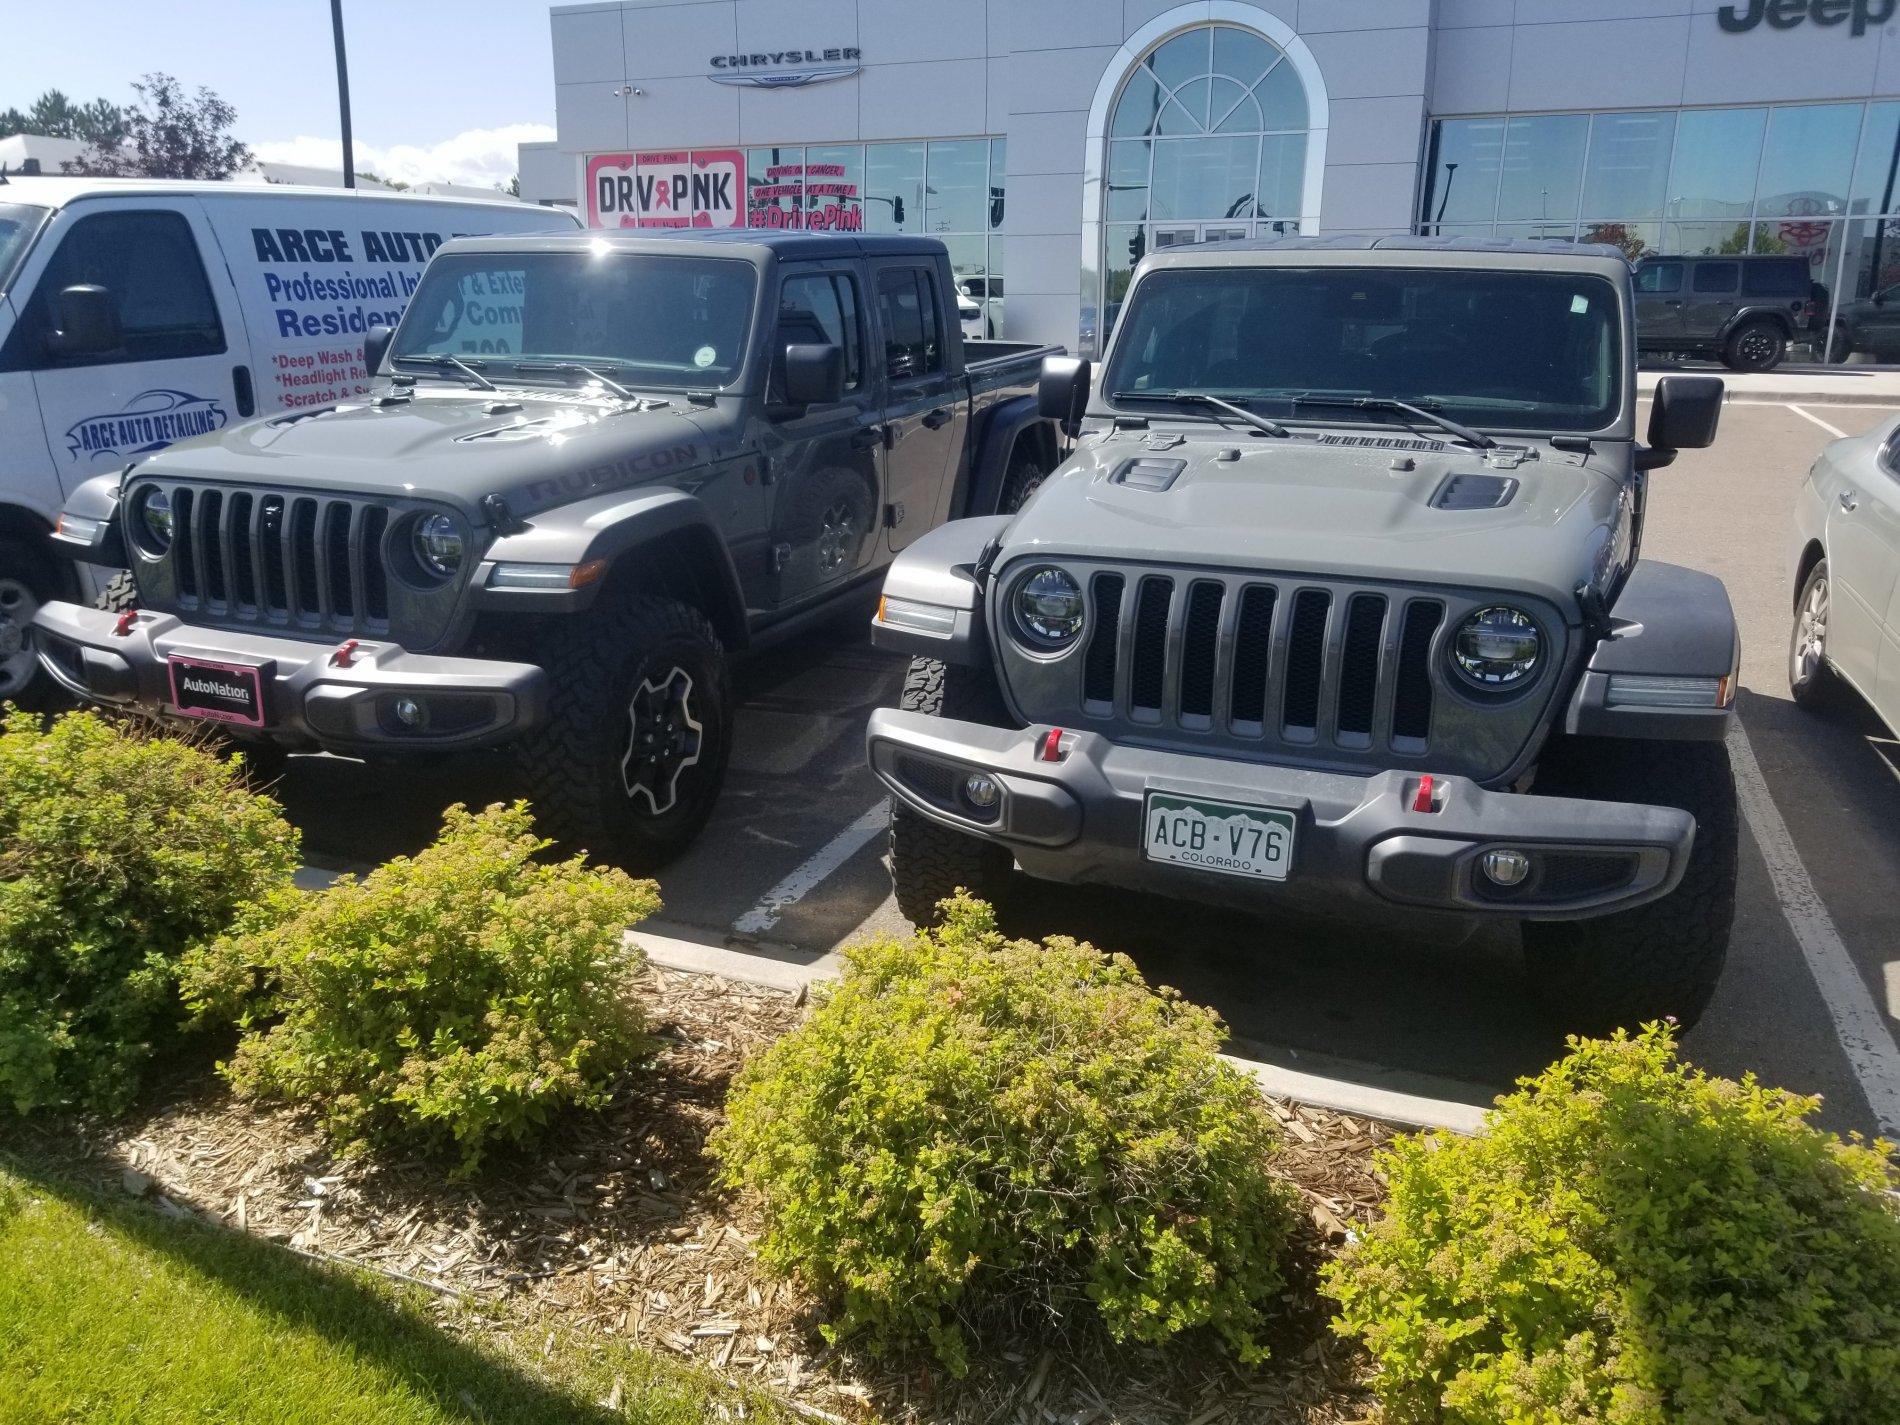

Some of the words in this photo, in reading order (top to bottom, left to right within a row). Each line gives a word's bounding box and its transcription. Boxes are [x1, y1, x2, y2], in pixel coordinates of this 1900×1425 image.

[1717, 0, 1896, 37] Jeep
[709, 47, 862, 69] CHRYSLER
[766, 166, 792, 177] DRIVING
[599, 174, 655, 213] DRV
[672, 172, 733, 211] PNK
[755, 188, 772, 197] ONE
[806, 184, 820, 194] AT
[750, 203, 863, 232] #DrivePink
[251, 228, 353, 262] ARCE
[263, 270, 398, 302] Professional
[488, 272, 525, 296] Exte
[275, 304, 408, 337] Residen
[466, 300, 523, 326] Com
[317, 349, 353, 365] Wash
[80, 421, 119, 450] ARCE
[118, 416, 154, 446] AUTO
[153, 408, 216, 440] DETAILING
[526, 443, 698, 501] RUBICON
[183, 677, 249, 699] AutoNation
[1181, 851, 1251, 869] COLORADO
